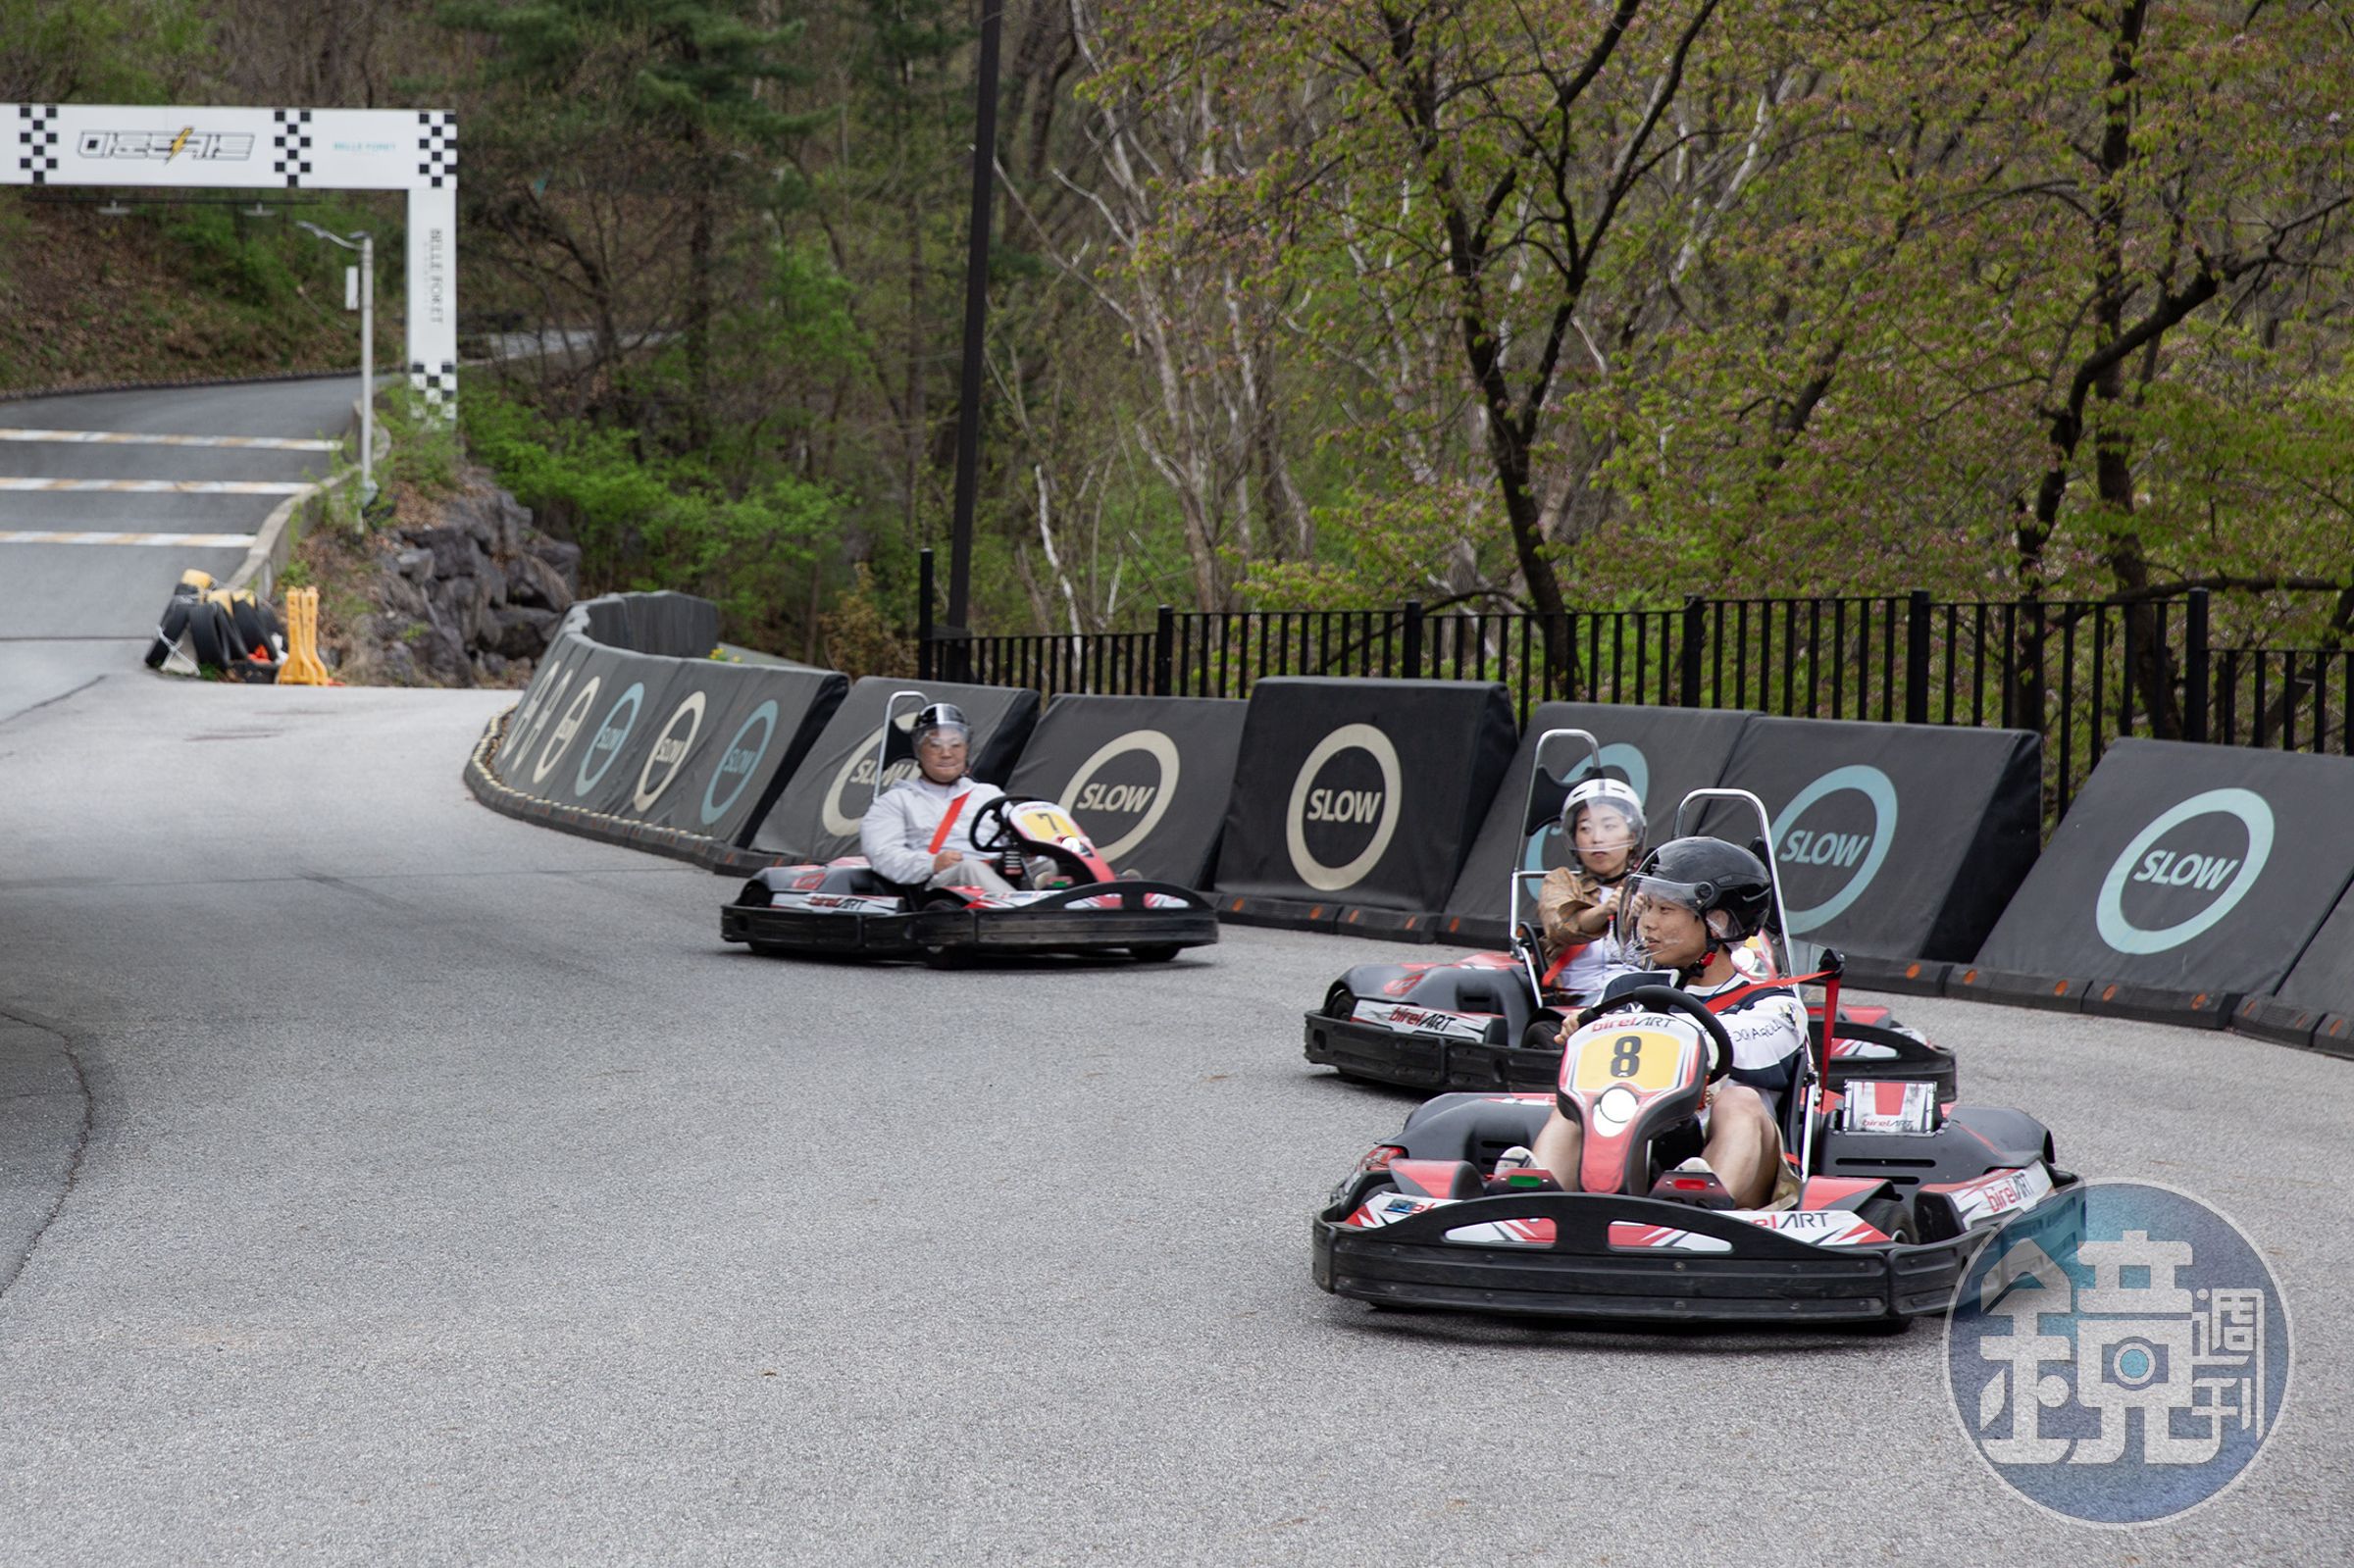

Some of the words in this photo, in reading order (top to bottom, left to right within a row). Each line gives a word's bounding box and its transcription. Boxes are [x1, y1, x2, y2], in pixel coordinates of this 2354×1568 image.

[723, 748, 758, 775] SLOW
[1077, 784, 1154, 813] SLOW
[1307, 788, 1382, 825] SLOW
[1036, 813, 1058, 832] 7
[1779, 829, 1870, 868] SLOW
[2132, 849, 2239, 892] SLOW
[1388, 1006, 1458, 1033] birelART
[1592, 1015, 1677, 1033] birelART
[1611, 1036, 1642, 1078] 8
